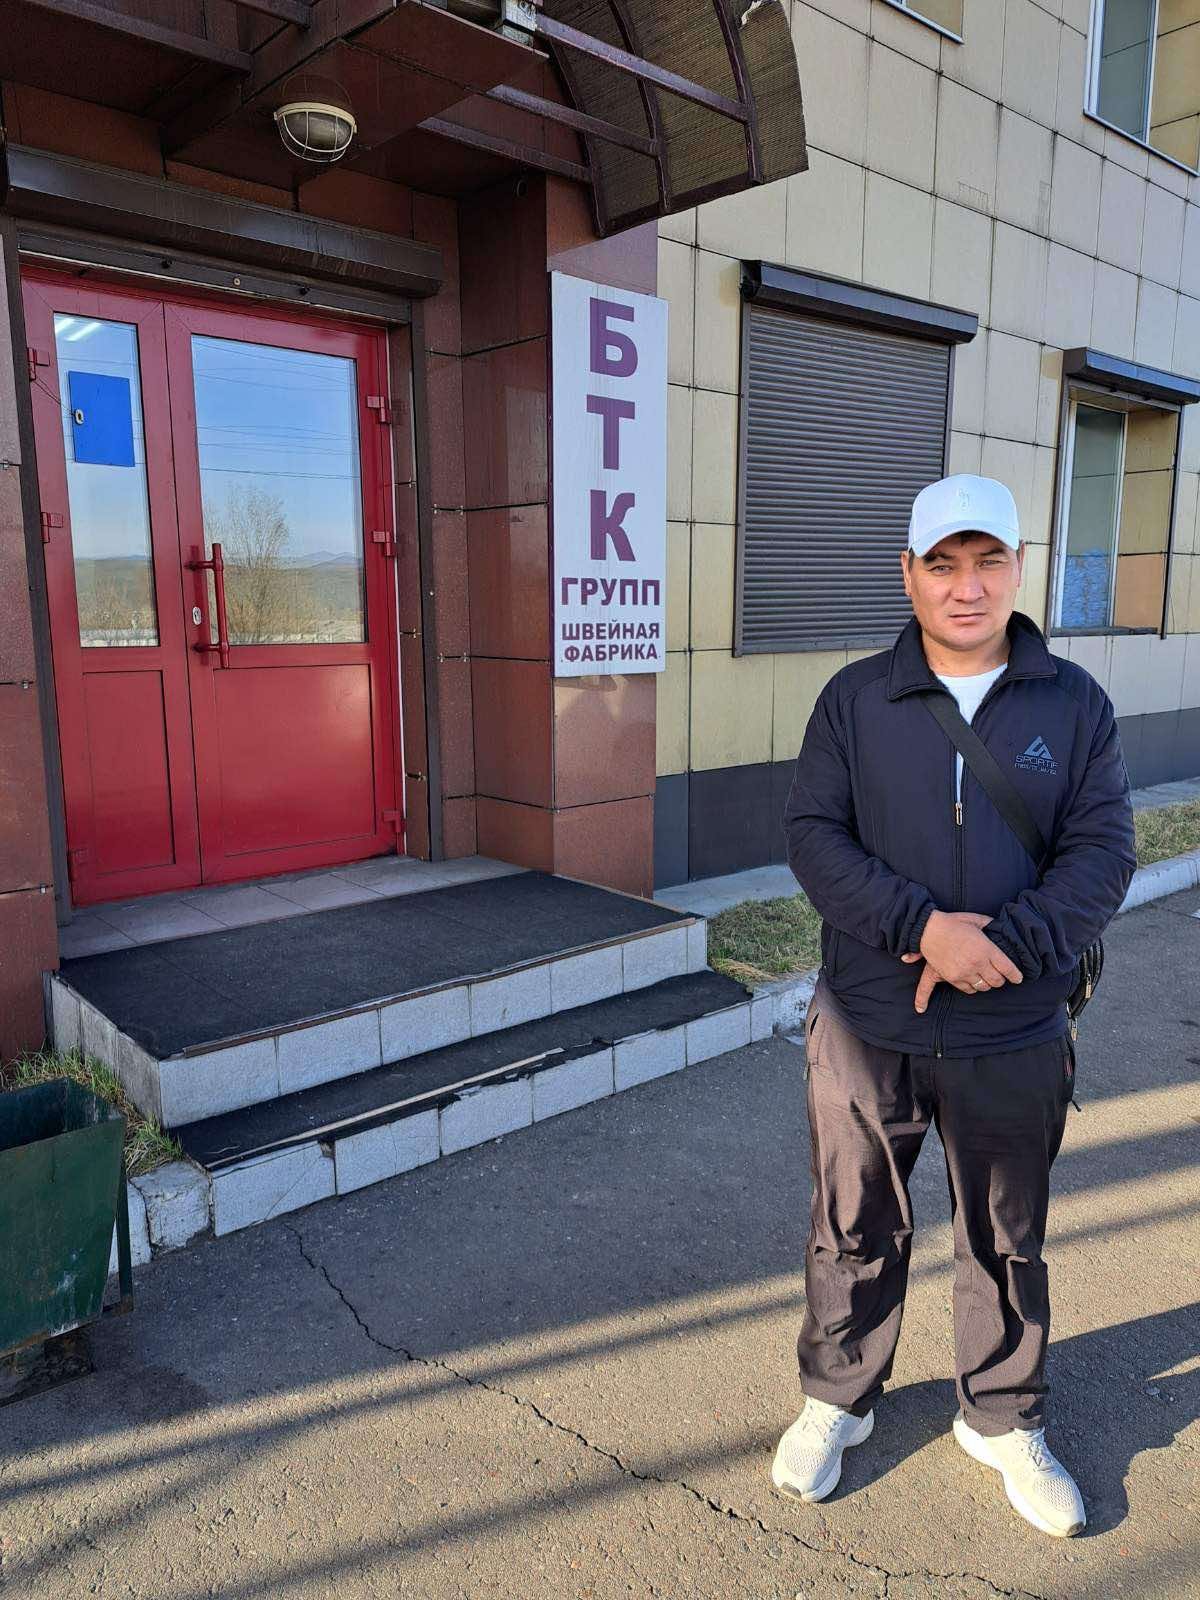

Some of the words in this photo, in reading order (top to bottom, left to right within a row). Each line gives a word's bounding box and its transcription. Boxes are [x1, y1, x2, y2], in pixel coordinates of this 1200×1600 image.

[586, 297, 638, 562] БТК
[561, 577, 660, 606] ГРУПП
[562, 619, 660, 640] ШВЕЙНАЯ
[564, 643, 658, 662] ФАБРИКА
